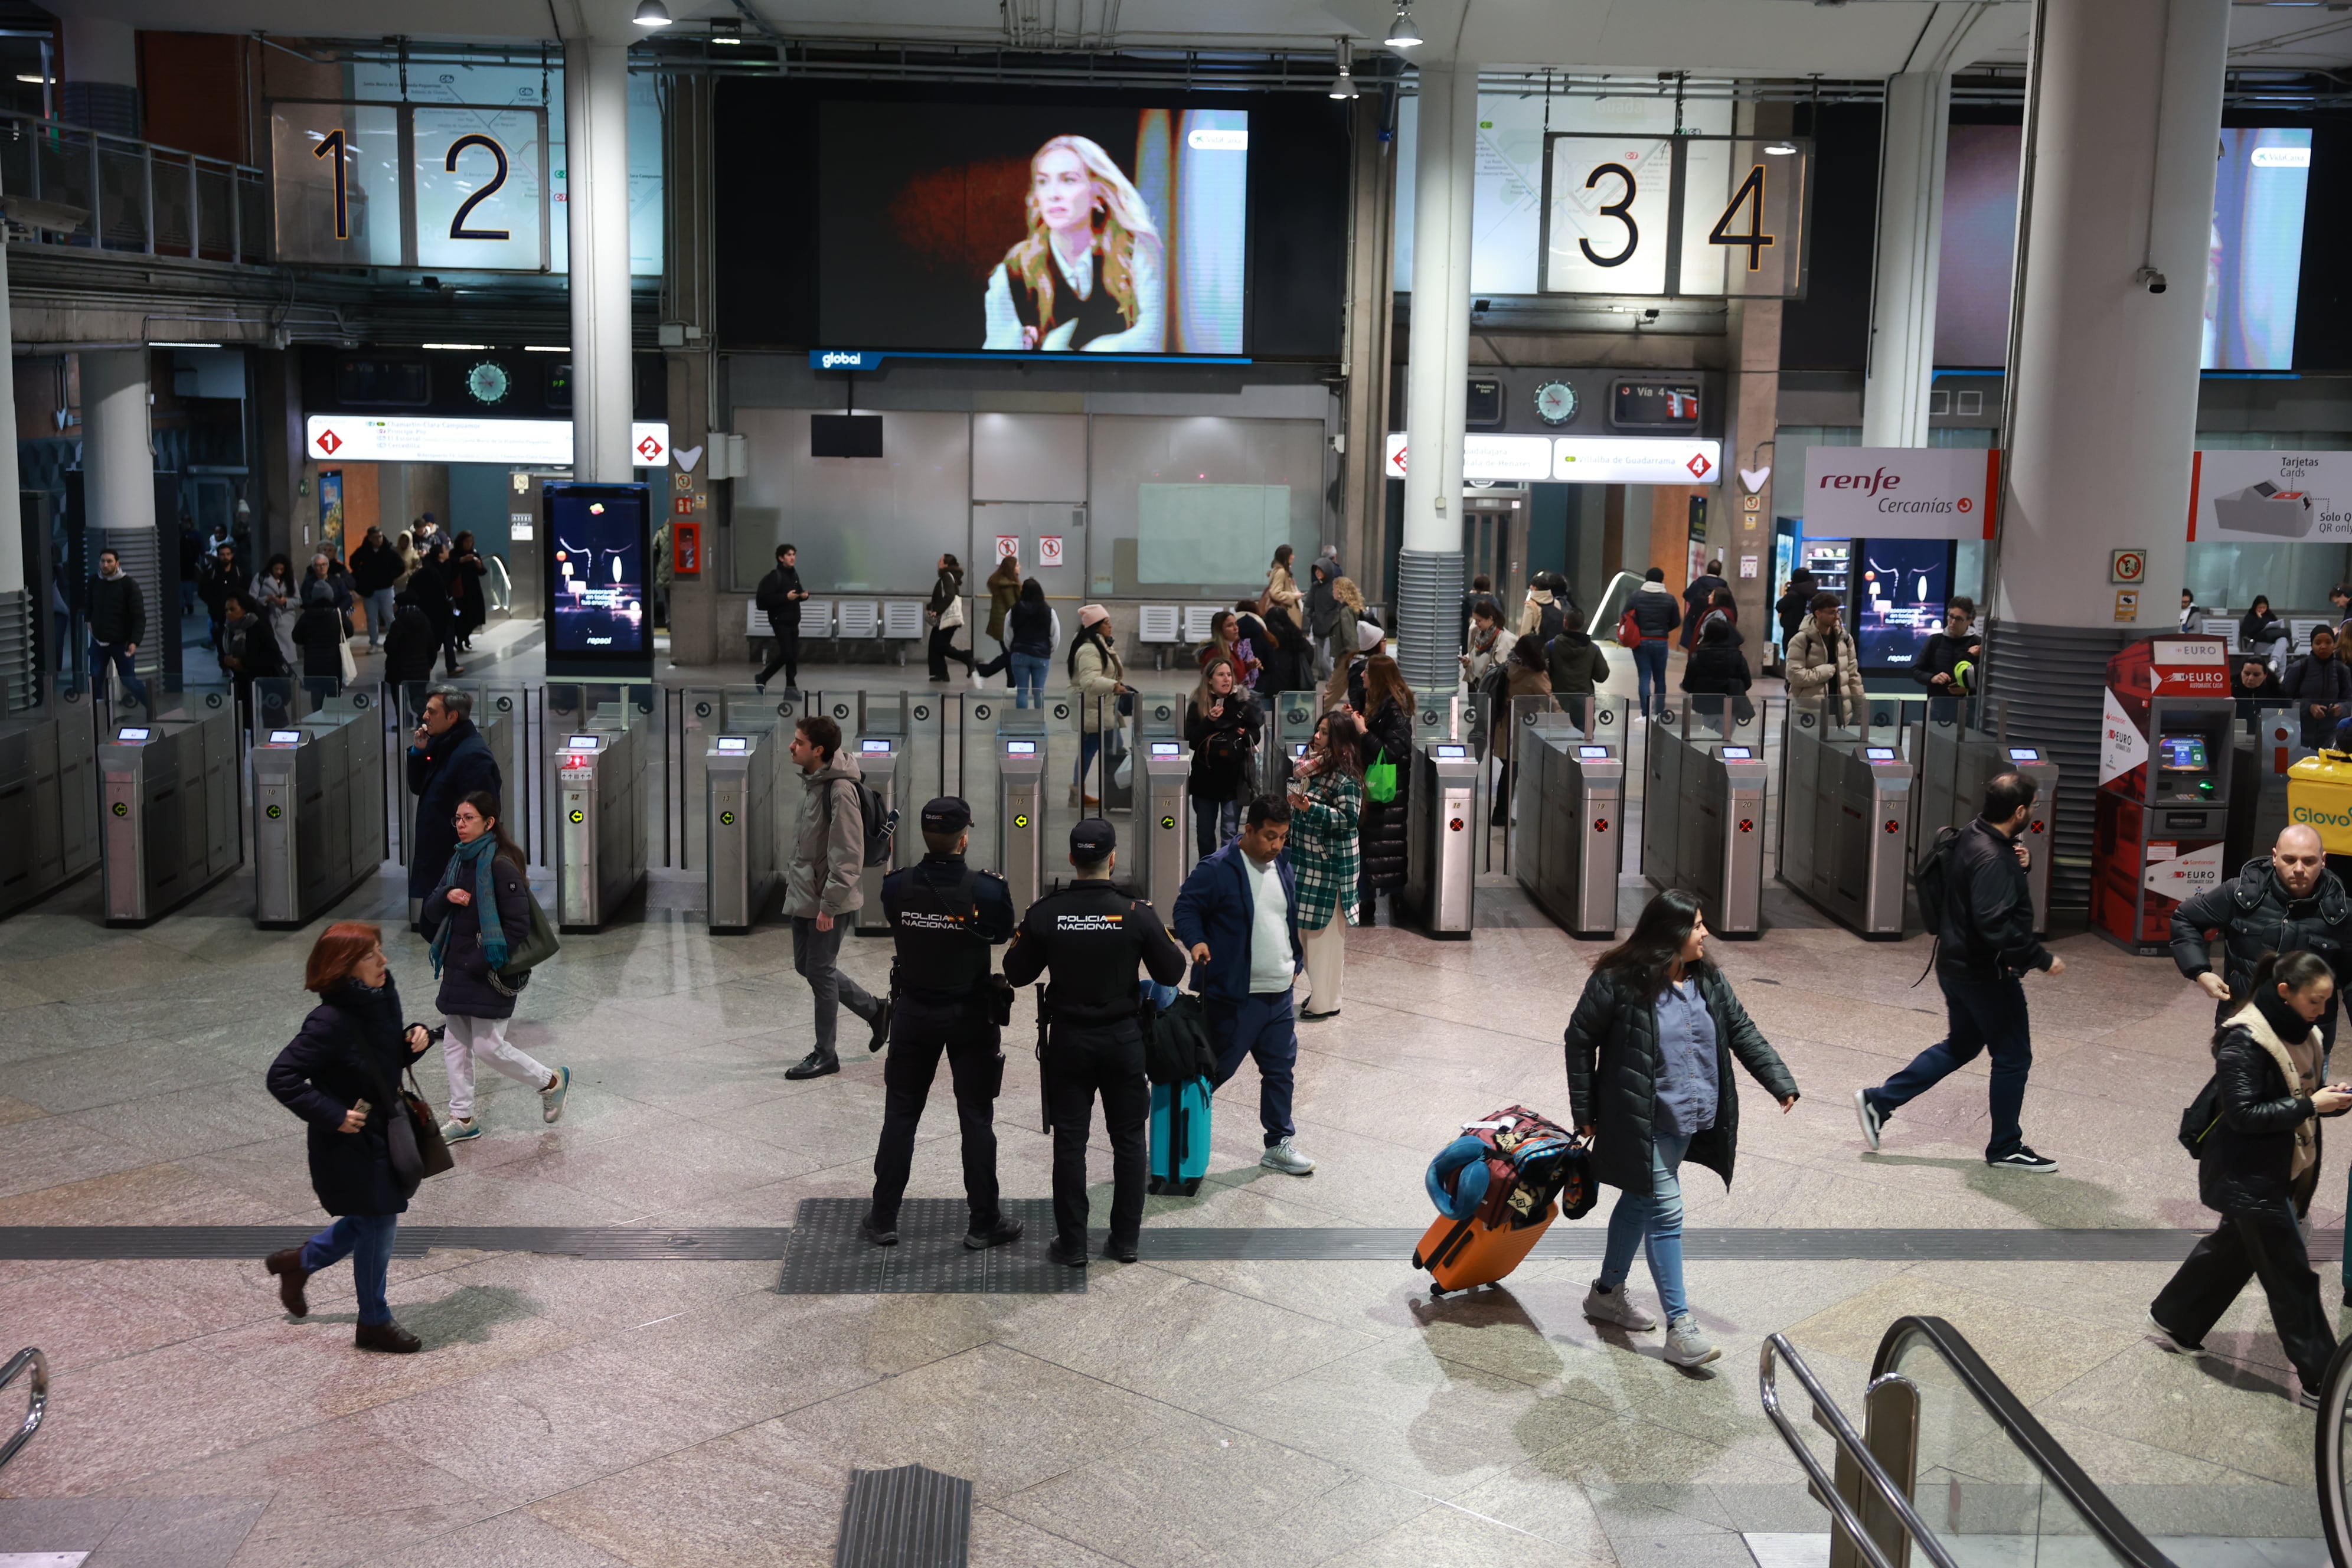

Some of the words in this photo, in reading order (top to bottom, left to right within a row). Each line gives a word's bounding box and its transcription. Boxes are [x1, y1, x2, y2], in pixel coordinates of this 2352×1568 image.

[312, 129, 348, 240] 1
[446, 133, 511, 240] 2
[1579, 162, 1639, 268] 3
[1709, 164, 1775, 272] 4
[822, 351, 861, 369] global
[1636, 386, 1654, 397] Vía
[1658, 387, 1665, 397] 4
[324, 433, 334, 451] 1
[643, 440, 656, 456] 2
[1464, 448, 1507, 458] uadalajara
[1579, 455, 1610, 463] Villalba
[1625, 456, 1675, 465] Guadarrama
[1692, 457, 1704, 473] 4
[2282, 456, 2319, 469] Tarjetas
[2281, 468, 2305, 478] Cards
[1819, 466, 1900, 497] renfe
[1878, 497, 1953, 514] Cercanías
[2320, 512, 2341, 522] Solo
[2344, 513, 2352, 524] Q
[2319, 523, 2333, 534] QR
[586, 636, 612, 646] repsol
[2184, 646, 2216, 655] EURO
[1886, 654, 1913, 663] repsol
[2188, 672, 2223, 682] EURO
[2115, 731, 2132, 746] EURO
[2293, 806, 2350, 827] Glovo
[2186, 871, 2214, 879] EURO
[901, 912, 950, 922] POLICIA
[901, 920, 964, 930] NACIONAL
[1057, 923, 1122, 931] NACIONAL
